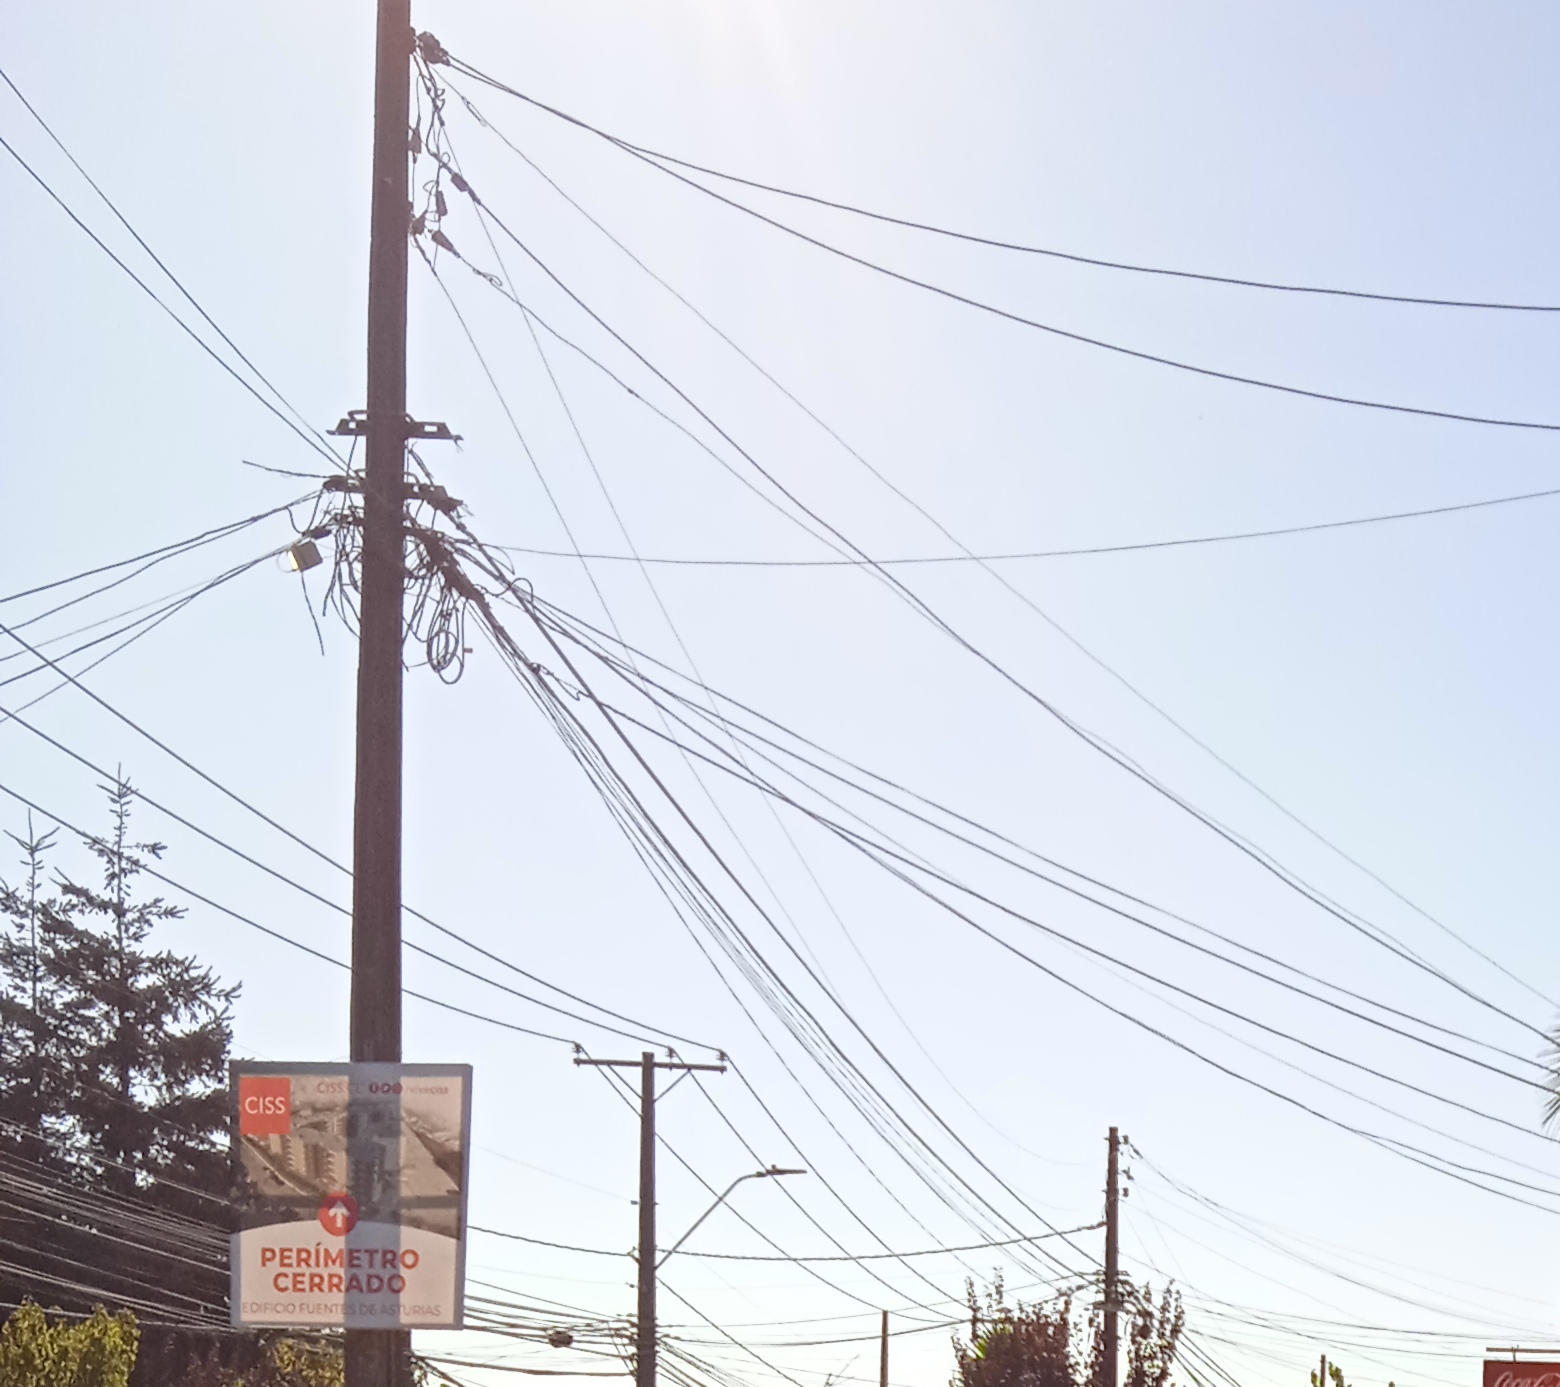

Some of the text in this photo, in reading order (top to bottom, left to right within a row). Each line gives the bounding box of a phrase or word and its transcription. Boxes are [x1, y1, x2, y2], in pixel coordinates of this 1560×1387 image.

[244, 1096, 286, 1115] CISS
[260, 1242, 420, 1270] PERÍMETRO
[272, 1272, 407, 1294] CERRADO
[242, 1302, 296, 1315] EDIFICIO
[300, 1303, 355, 1315] FUENTES
[379, 1303, 442, 1317] ASTURIAS
